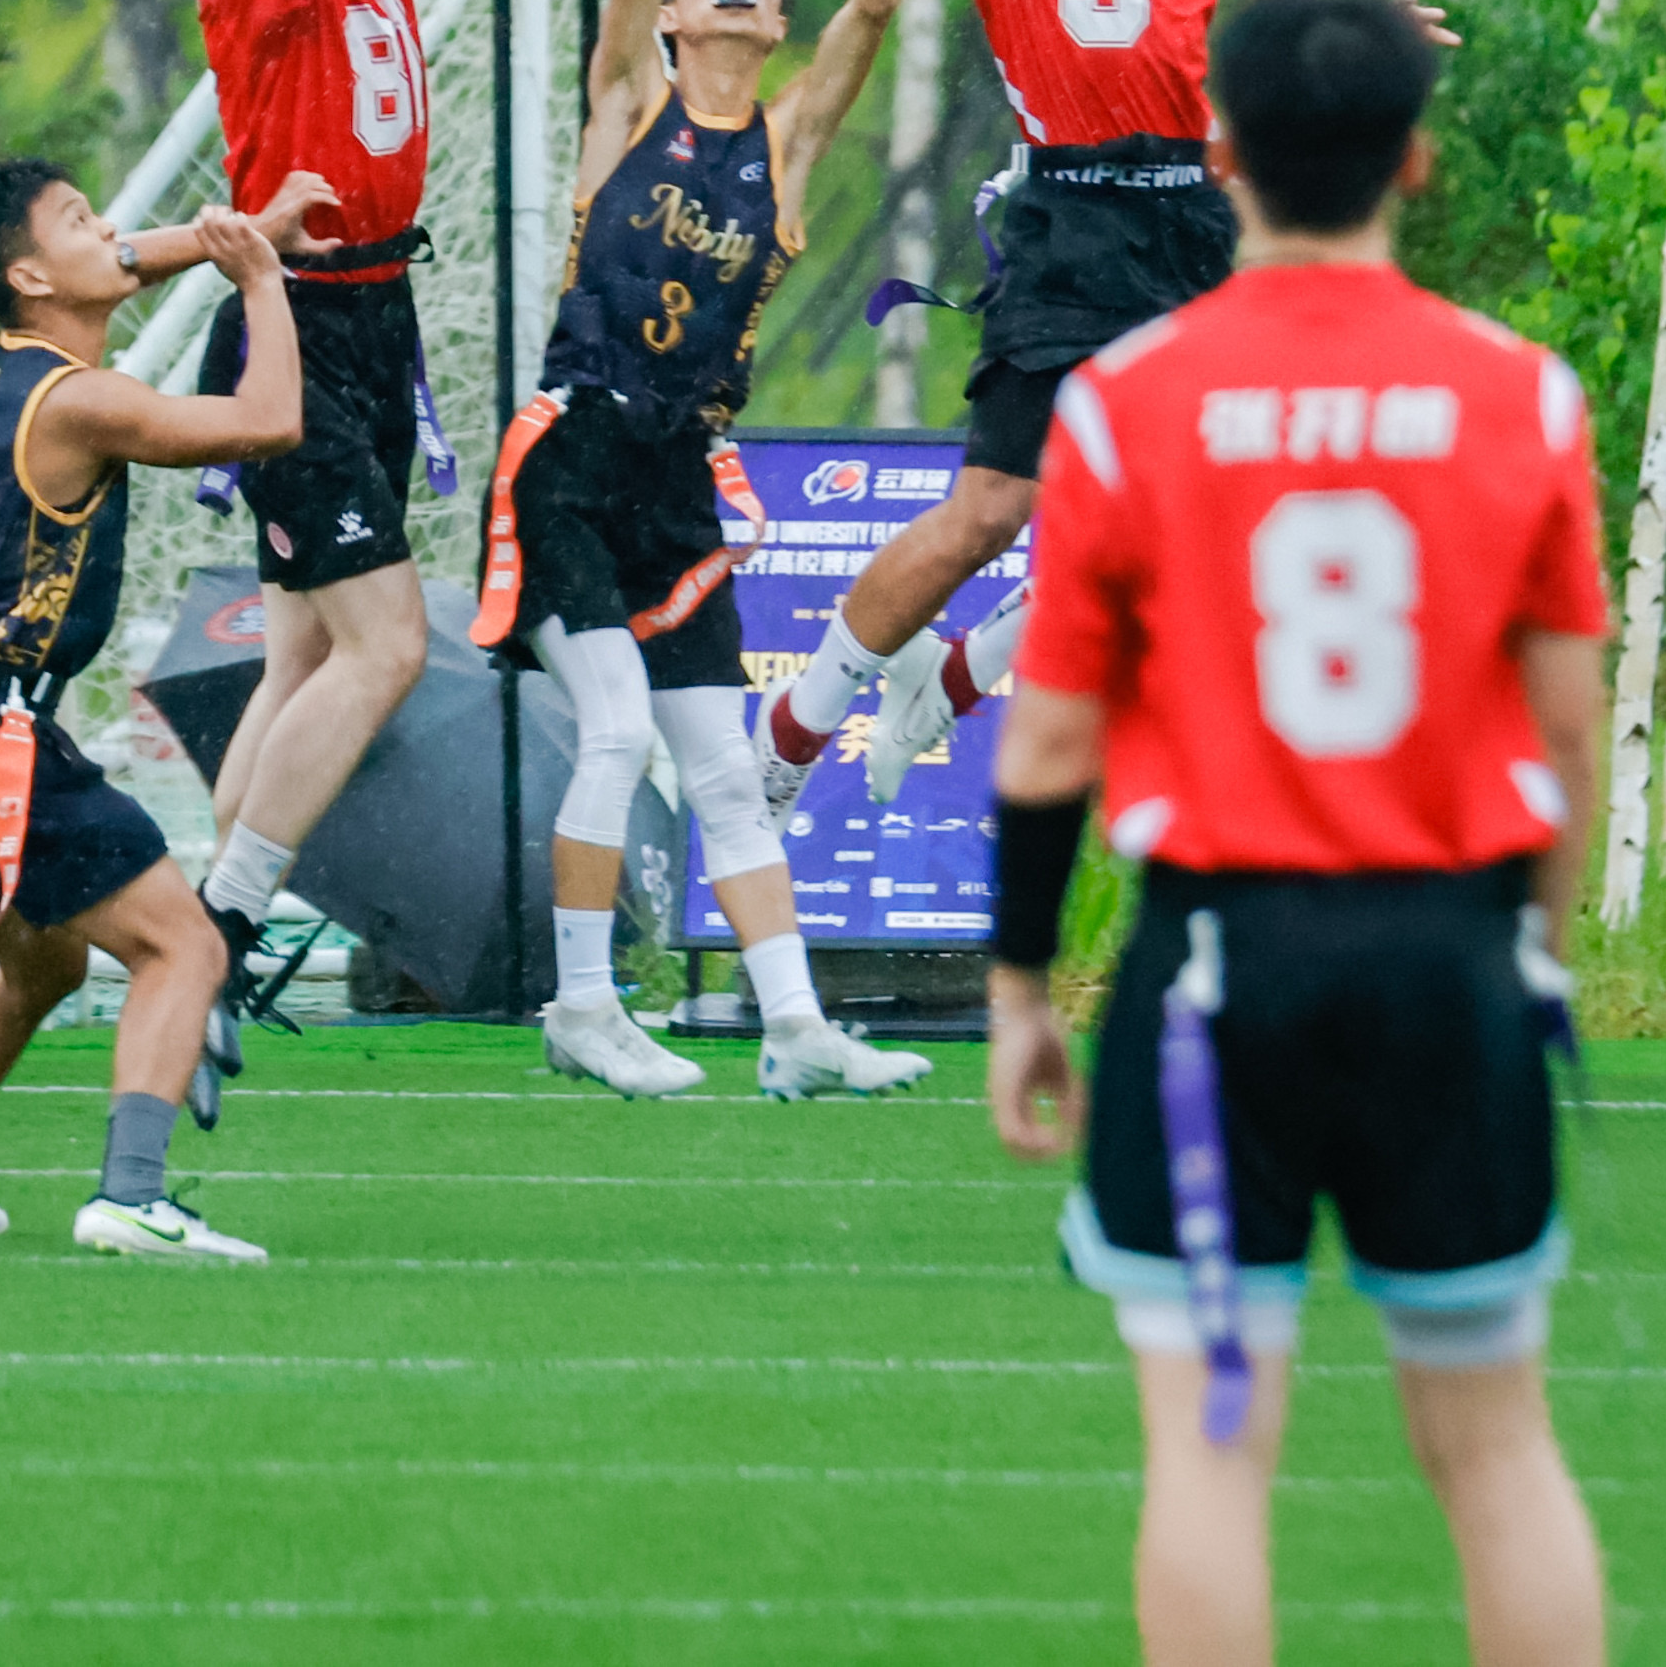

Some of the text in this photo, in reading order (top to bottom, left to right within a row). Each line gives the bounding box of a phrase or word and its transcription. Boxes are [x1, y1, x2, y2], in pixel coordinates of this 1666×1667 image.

[1043, 162, 1204, 188] RIPLEWIN
[643, 280, 695, 356] 3
[1249, 488, 1422, 761] 8
